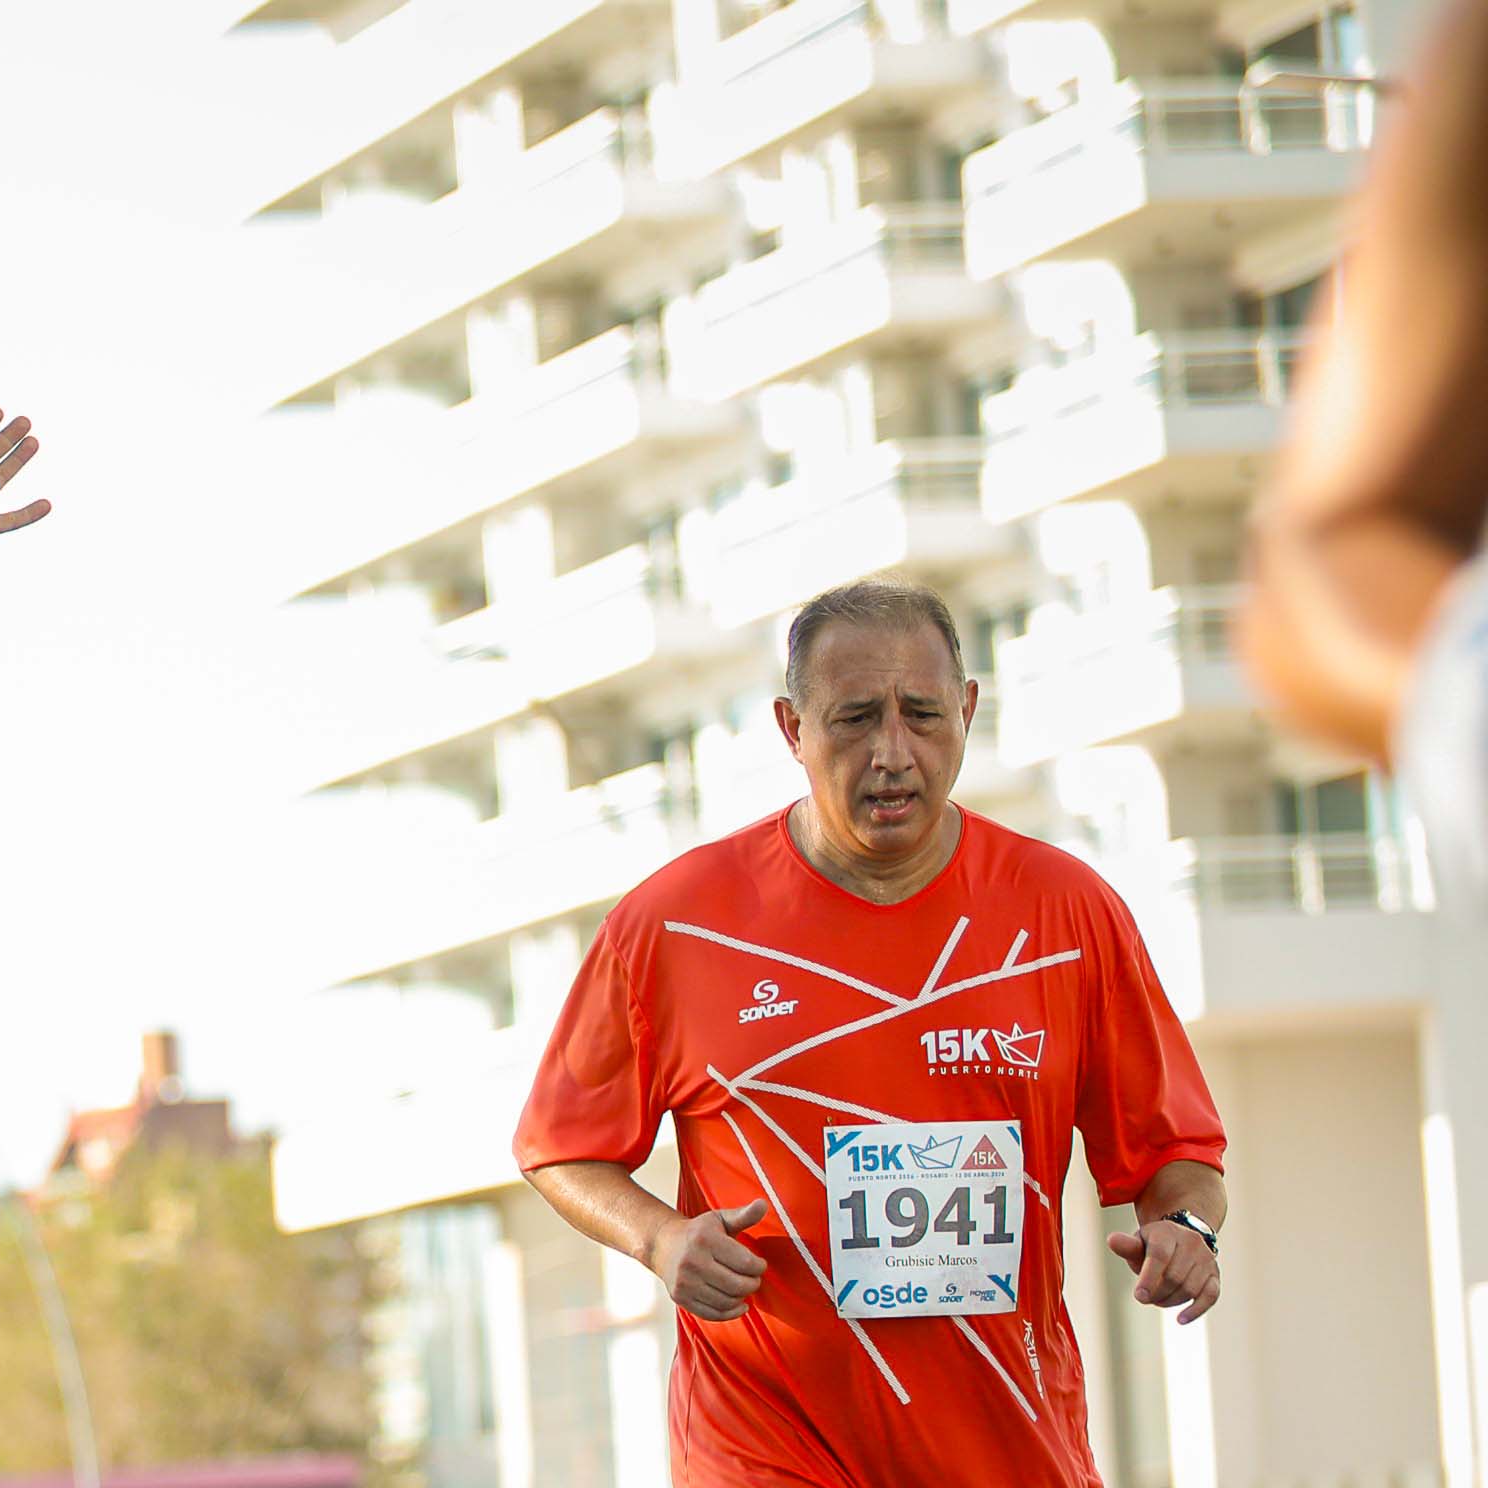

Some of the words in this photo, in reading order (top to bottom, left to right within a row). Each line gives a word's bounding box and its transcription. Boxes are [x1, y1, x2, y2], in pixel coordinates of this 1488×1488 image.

[920, 1028, 991, 1064] 15K
[928, 1065, 991, 1077] PUERTO
[997, 1066, 1039, 1080] NORTE
[847, 1143, 905, 1173] 15K
[972, 1151, 998, 1166] 15K
[839, 1185, 1014, 1250] 1941
[885, 1255, 934, 1268] Grubisic
[937, 1254, 978, 1266] Marcos
[863, 1280, 929, 1308] osde
